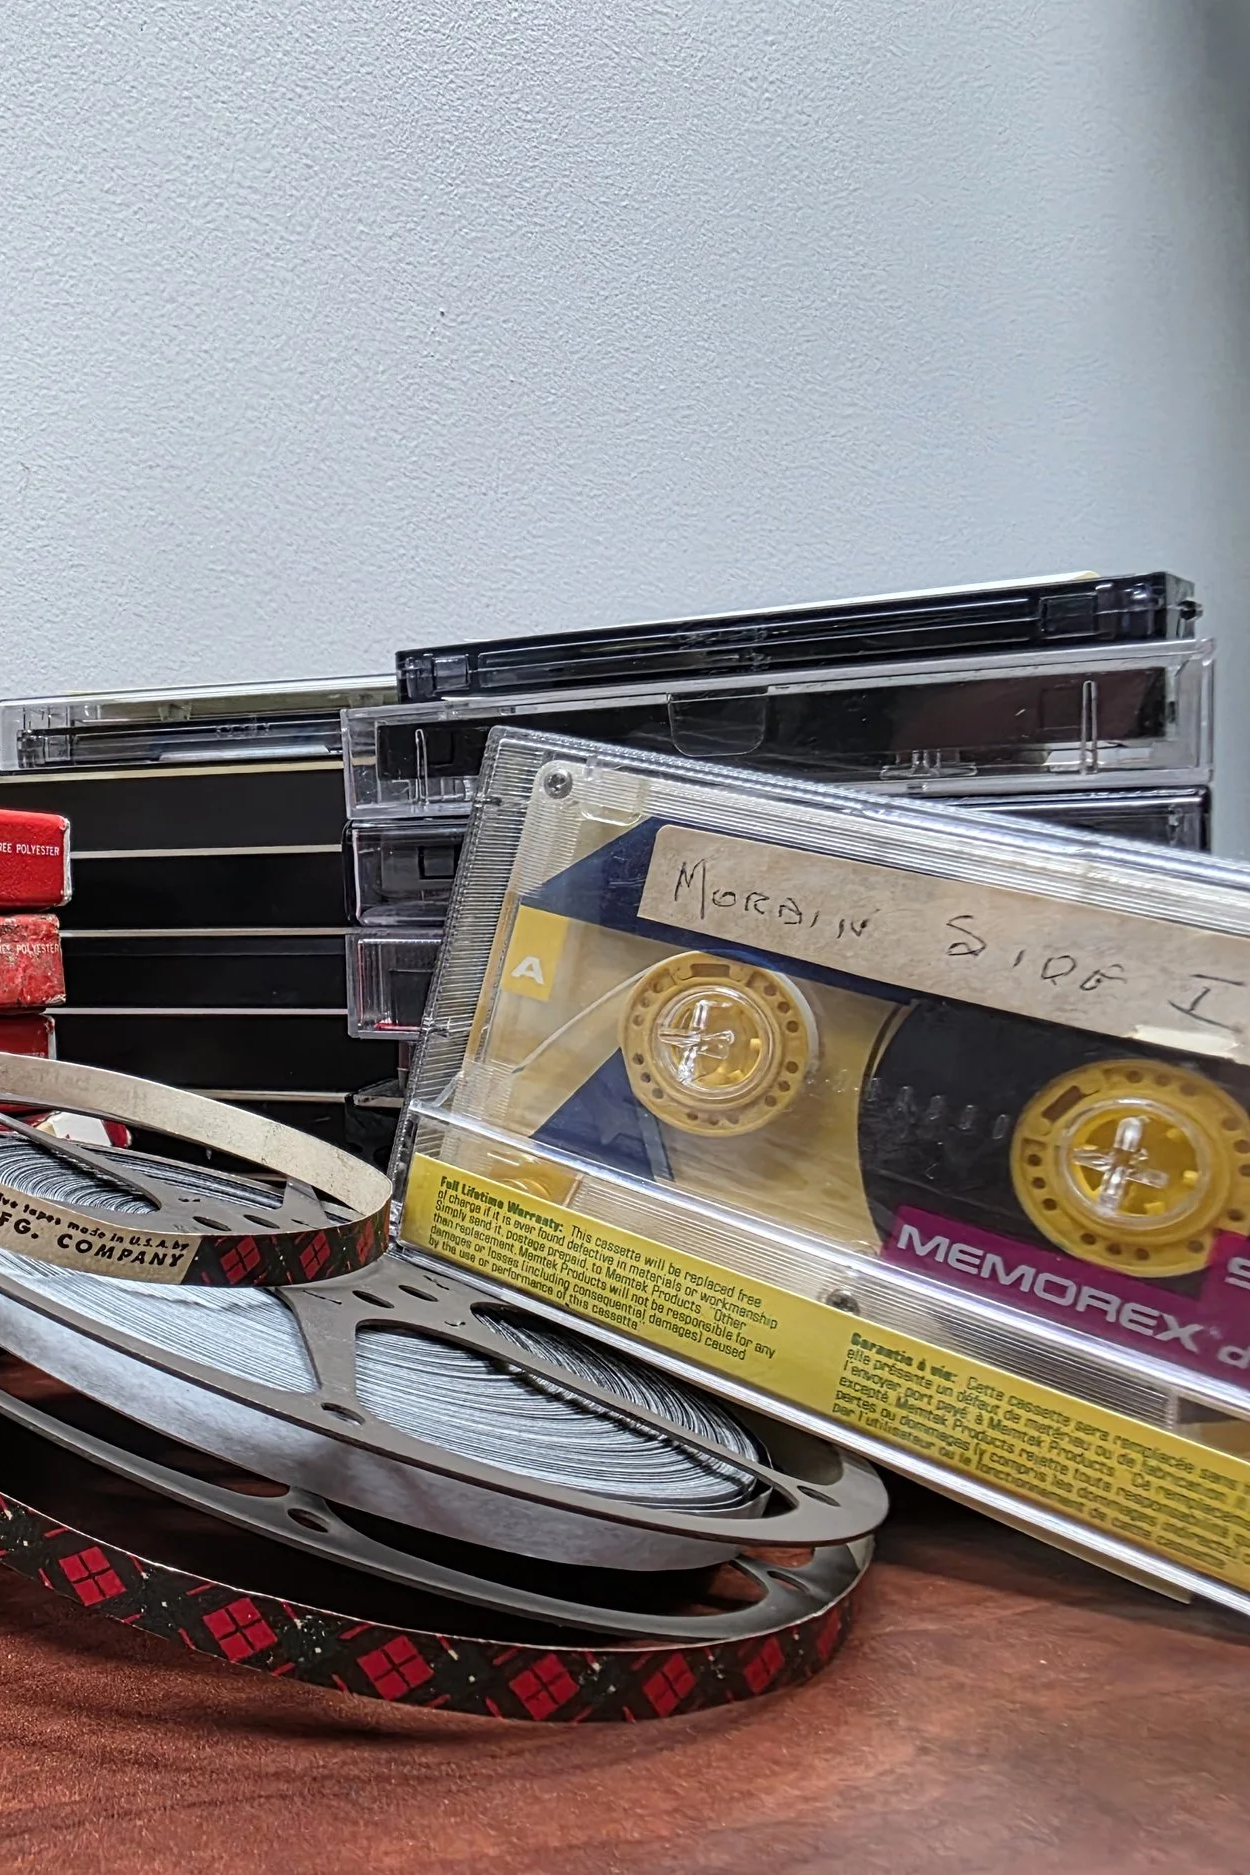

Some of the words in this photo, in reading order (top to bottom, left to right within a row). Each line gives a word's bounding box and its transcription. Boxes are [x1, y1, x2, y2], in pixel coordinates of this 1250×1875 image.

[16, 844, 59, 856] POLYESTER
[510, 956, 545, 986] A
[23, 1204, 61, 1225] tapes
[68, 1222, 106, 1239] made
[109, 1233, 124, 1243] in
[172, 1240, 190, 1252] by
[57, 1233, 185, 1267] COMPANY
[427, 1234, 439, 1249] by
[441, 1240, 456, 1254] the
[458, 1249, 475, 1263] use
[477, 1257, 489, 1269] or
[490, 1260, 554, 1295] performance
[555, 1285, 567, 1301] of
[568, 1293, 589, 1310] this
[434, 1198, 467, 1222] Simply
[468, 1212, 492, 1231] send
[505, 1228, 545, 1253] postage
[591, 1261, 602, 1274] to
[605, 1265, 648, 1293] Memtek
[437, 1187, 447, 1201] of
[448, 1191, 481, 1215] charge
[483, 1205, 491, 1218] if
[492, 1210, 499, 1221] it
[502, 1212, 512, 1225] is
[513, 1218, 536, 1235] ever
[537, 1226, 565, 1246] found
[566, 1237, 614, 1266] defective
[616, 1257, 627, 1270] in
[628, 1260, 682, 1292] materials
[684, 1285, 698, 1299] or
[699, 1288, 778, 1330] workmanship
[439, 1175, 459, 1192] Full
[460, 1183, 504, 1210] Lifetime
[506, 1200, 564, 1234] Warranty:
[570, 1224, 592, 1243] This
[594, 1235, 641, 1262] cassette
[644, 1253, 665, 1271] will
[667, 1262, 682, 1277] be
[683, 1268, 735, 1300] replaced
[737, 1288, 762, 1308] free
[430, 1223, 472, 1250] damages
[473, 1242, 485, 1253] or
[487, 1246, 519, 1268] losses
[571, 1281, 646, 1321] consequential
[704, 1334, 746, 1361] caused
[432, 1211, 453, 1228] than
[517, 1244, 559, 1271] Memtek
[560, 1260, 608, 1291] Products
[608, 1282, 629, 1299] will
[630, 1291, 649, 1307] not
[650, 1298, 664, 1314] be
[665, 1304, 733, 1342] responsible
[735, 1331, 753, 1348] for
[754, 1341, 775, 1359] any
[897, 1224, 1204, 1353] MEMOREX
